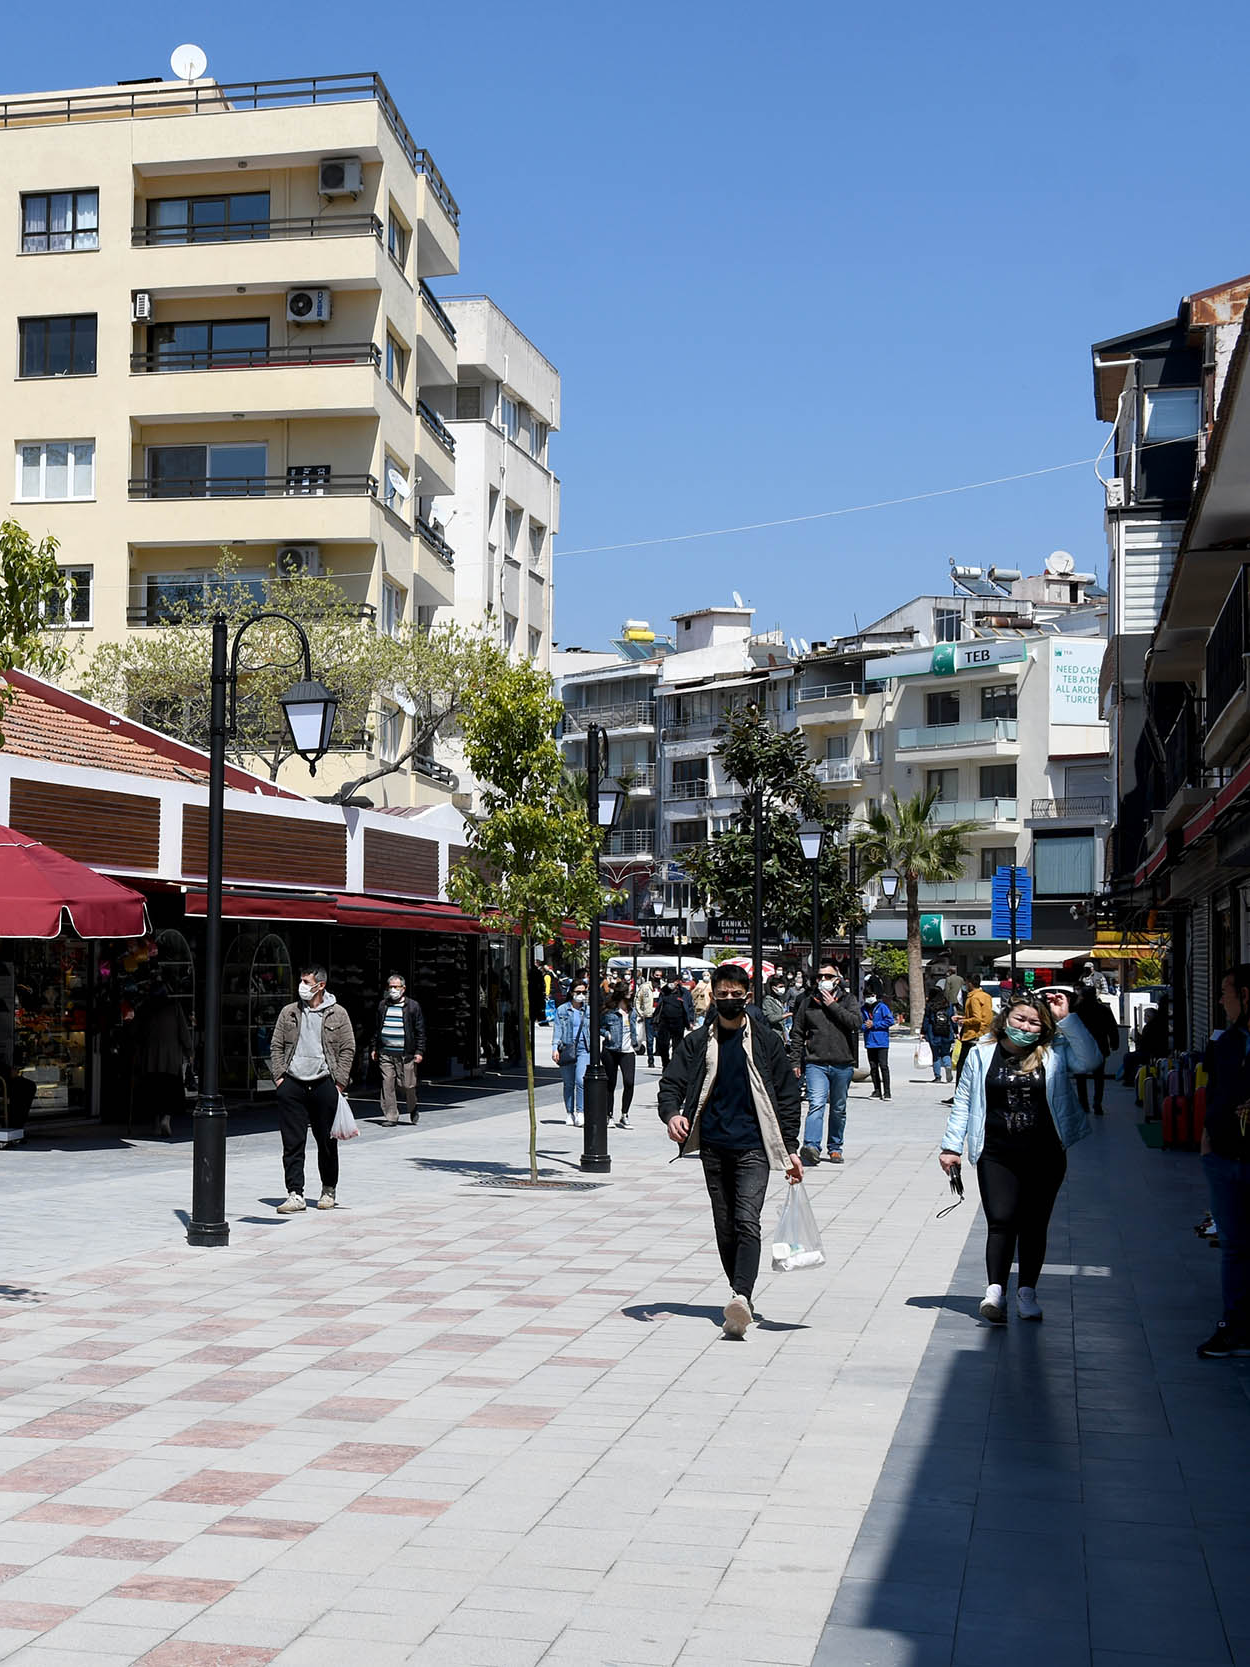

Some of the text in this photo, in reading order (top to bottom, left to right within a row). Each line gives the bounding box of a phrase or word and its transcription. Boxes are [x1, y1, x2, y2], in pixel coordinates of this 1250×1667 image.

[965, 649, 990, 663] TEB
[1056, 665, 1079, 674] NEED
[1062, 675, 1078, 684] TEB
[1056, 684, 1099, 694] ALL AROU
[1066, 695, 1099, 704] TURKEY
[951, 924, 976, 936] TEB
